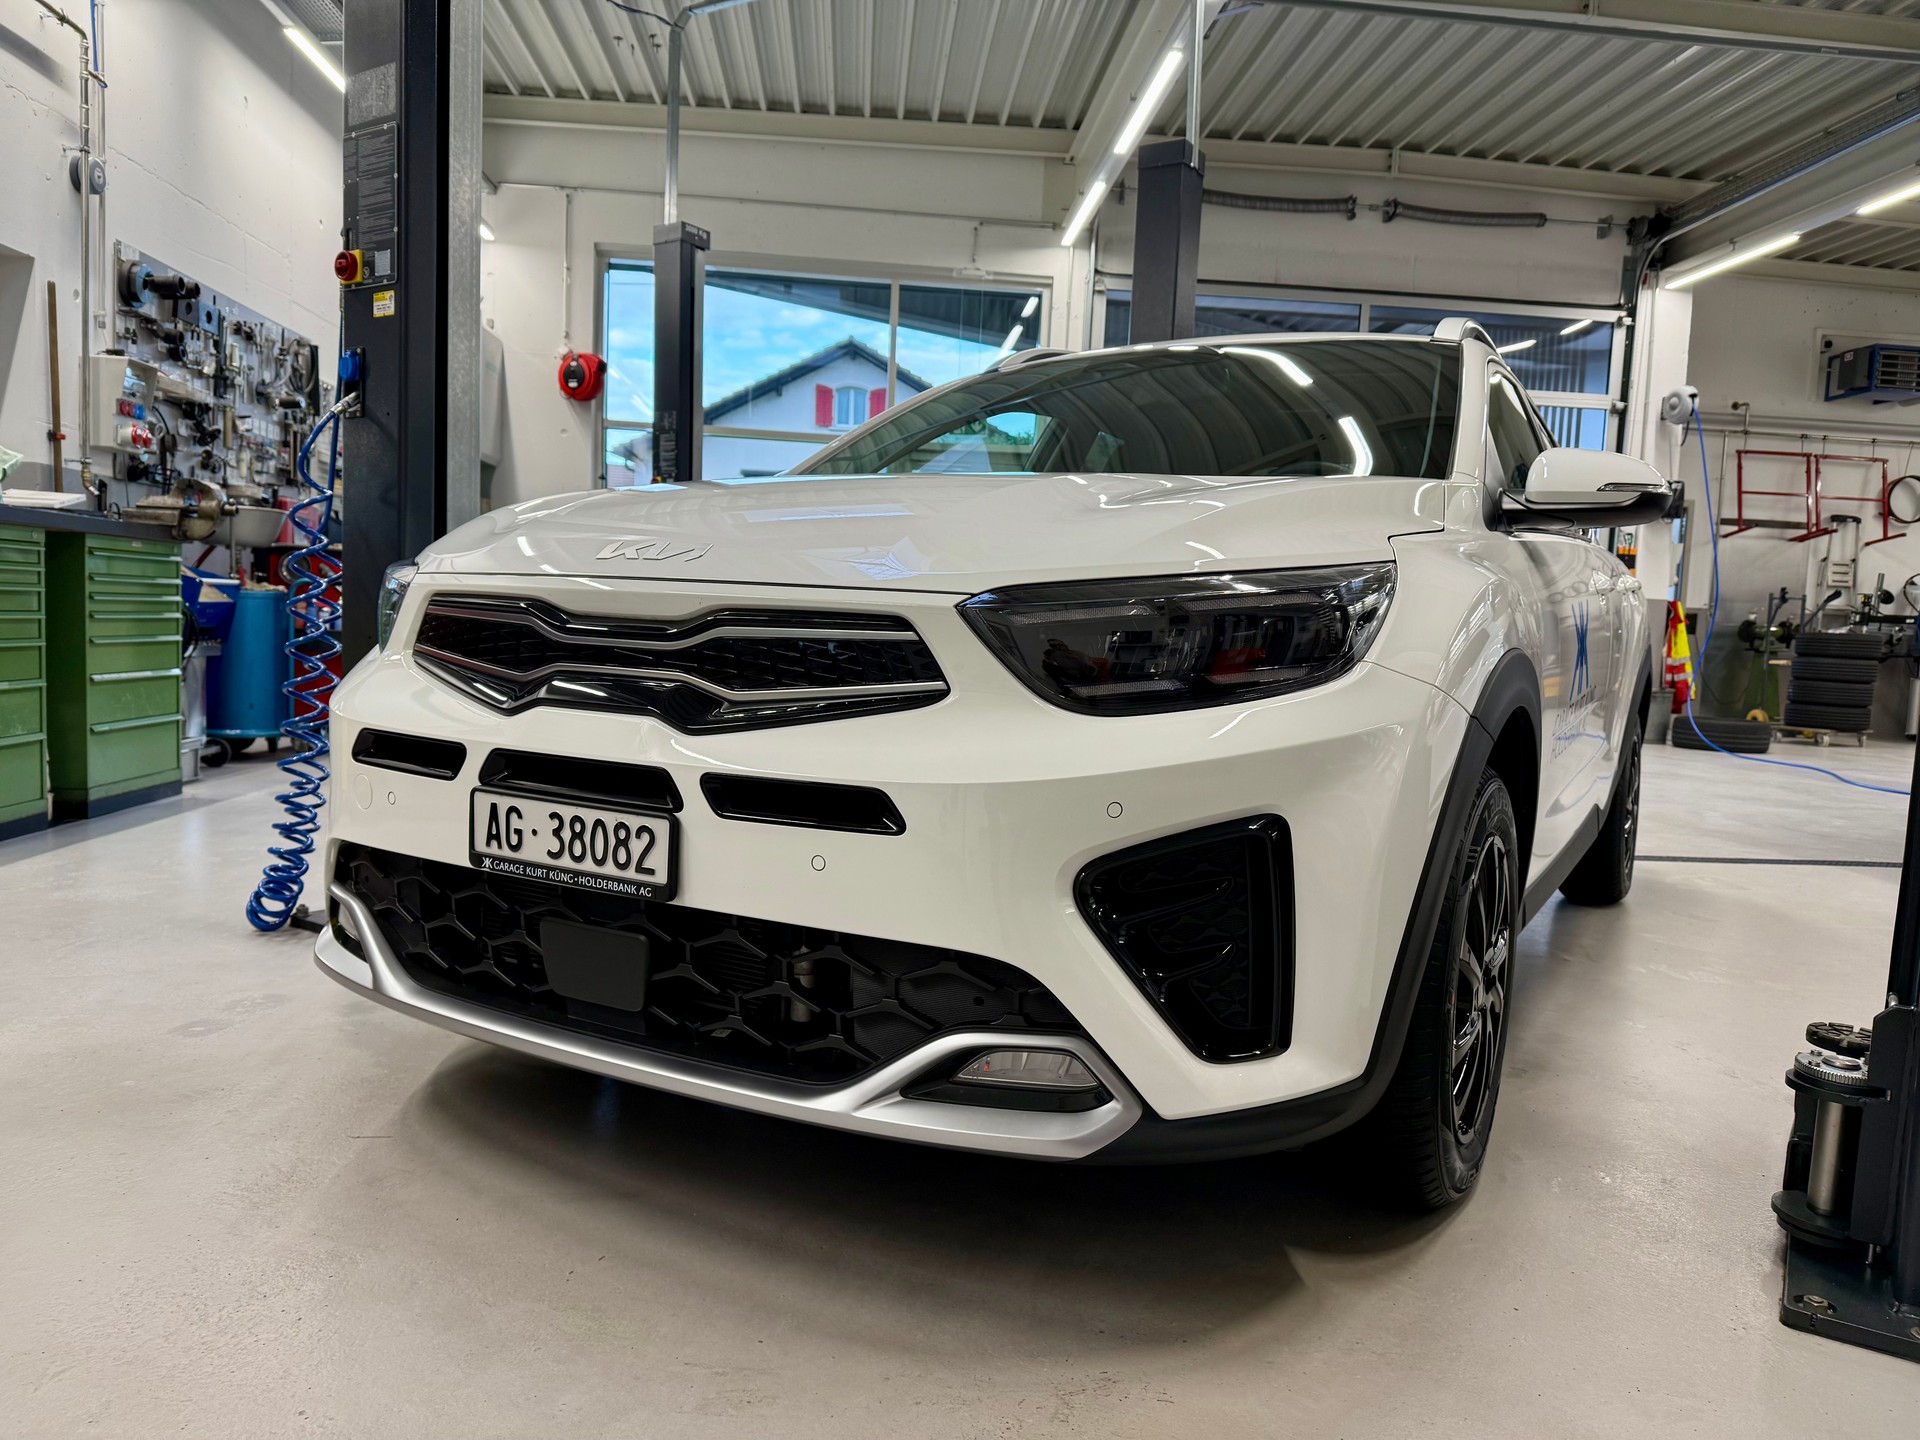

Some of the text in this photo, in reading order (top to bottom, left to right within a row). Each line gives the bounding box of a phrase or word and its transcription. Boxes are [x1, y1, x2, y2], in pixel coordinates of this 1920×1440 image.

[493, 861, 524, 875] GARAGE
[526, 866, 547, 878] KURT
[638, 887, 652, 897] AG
